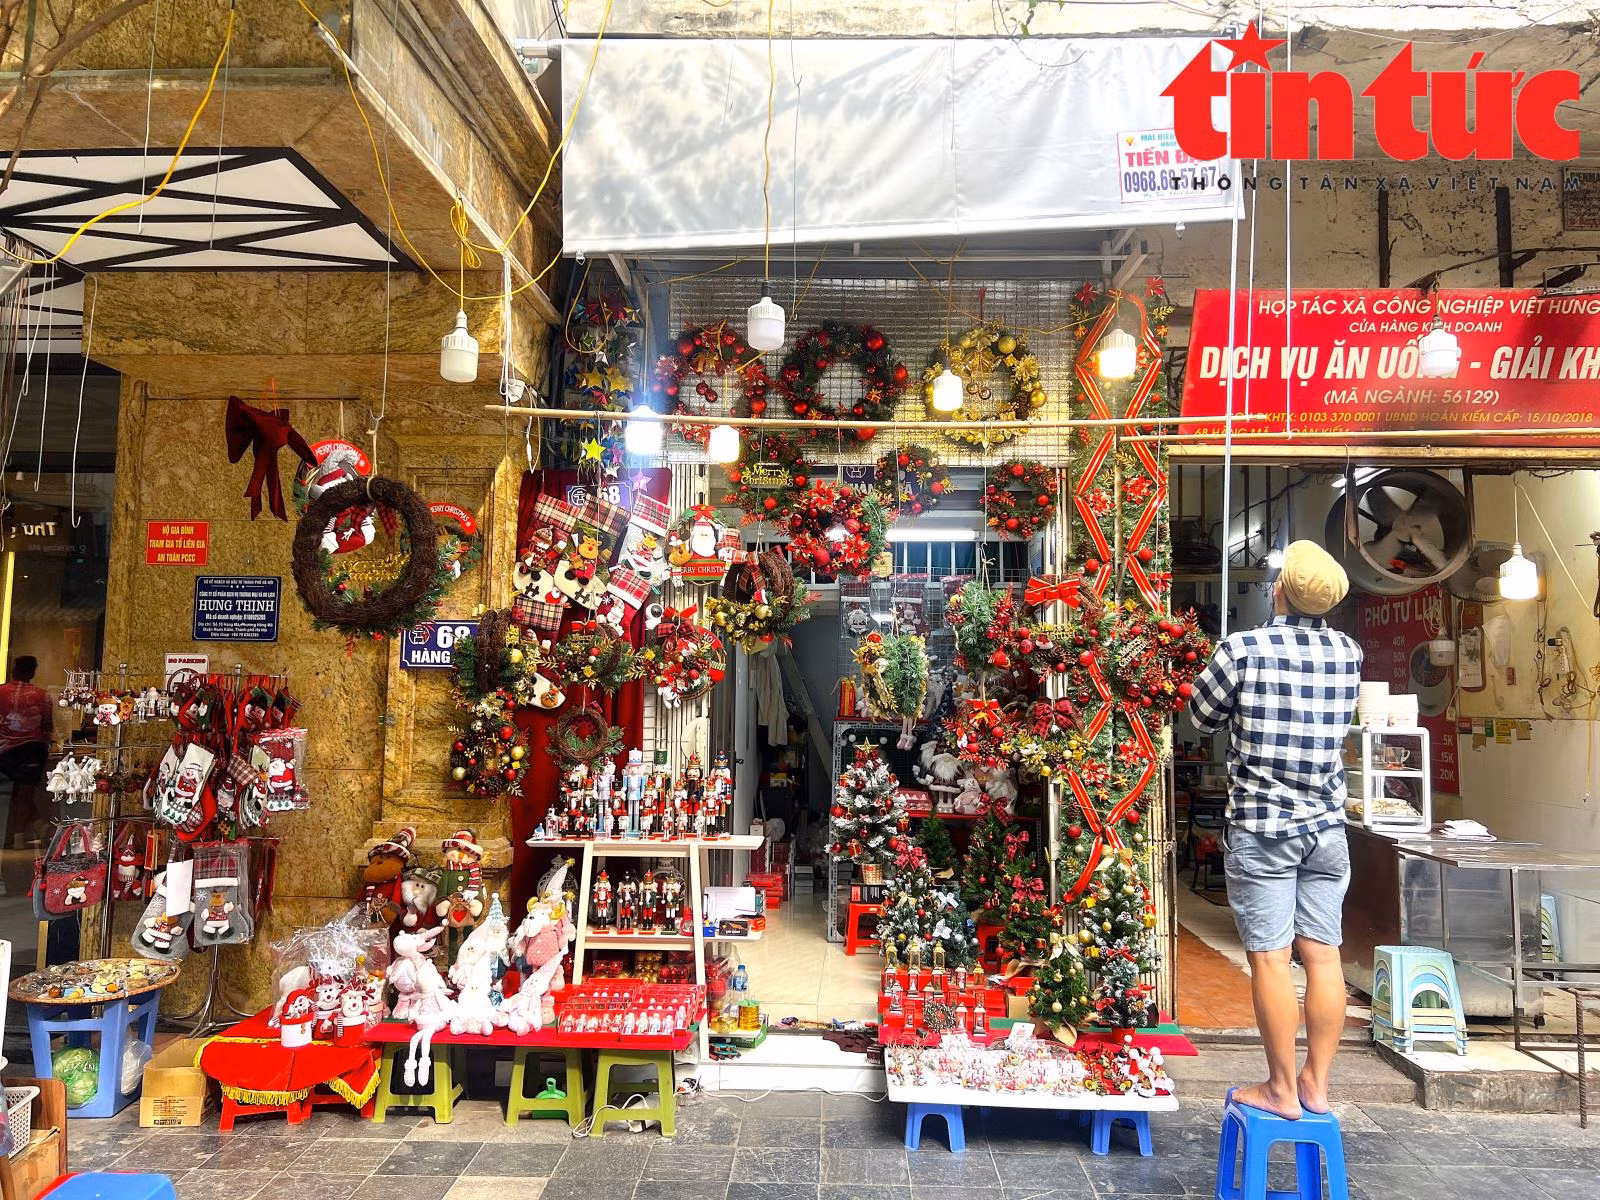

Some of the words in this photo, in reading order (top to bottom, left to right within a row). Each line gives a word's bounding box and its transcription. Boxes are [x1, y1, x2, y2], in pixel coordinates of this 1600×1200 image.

[1258, 298, 1297, 317] HỢP
[1301, 296, 1337, 314] TÁC
[1340, 296, 1367, 314] XÃ
[1372, 297, 1432, 314] CÔNG
[1437, 296, 1504, 317] NGHIỆP
[1509, 296, 1547, 317] VIỆT
[1548, 298, 1600, 315] HƯNG
[1349, 318, 1376, 333] CỬA
[1379, 319, 1418, 333] HÀNG
[1421, 322, 1451, 333] KIH
[1454, 322, 1503, 333] DOANH
[1200, 346, 1271, 386] DỊCH
[1280, 346, 1319, 386] VỤ
[1324, 339, 1370, 379] ĂN
[1490, 335, 1555, 379] GIẢI
[1324, 387, 1361, 405] (MÃ
[1364, 385, 1435, 404] NGÀNH:
[1442, 390, 1499, 405] 56129)
[1300, 412, 1328, 422] 0103
[1330, 412, 1351, 422] 370
[1354, 412, 1380, 422] 0001
[1385, 412, 1417, 422] UBND
[1420, 410, 1459, 422] HOÀN
[1461, 409, 1490, 422] KIẾM
[1493, 409, 1522, 423] CẤP:
[1527, 412, 1593, 423] 15/10/2018
[170, 526, 180, 535] GIA
[165, 539, 175, 548] GIA
[196, 539, 206, 548] GIA
[157, 553, 166, 562] AN
[181, 553, 196, 562] PCCC
[697, 566, 725, 574] CHRISTM
[1365, 596, 1390, 627] PHỞ
[411, 648, 451, 663] HÀNG
